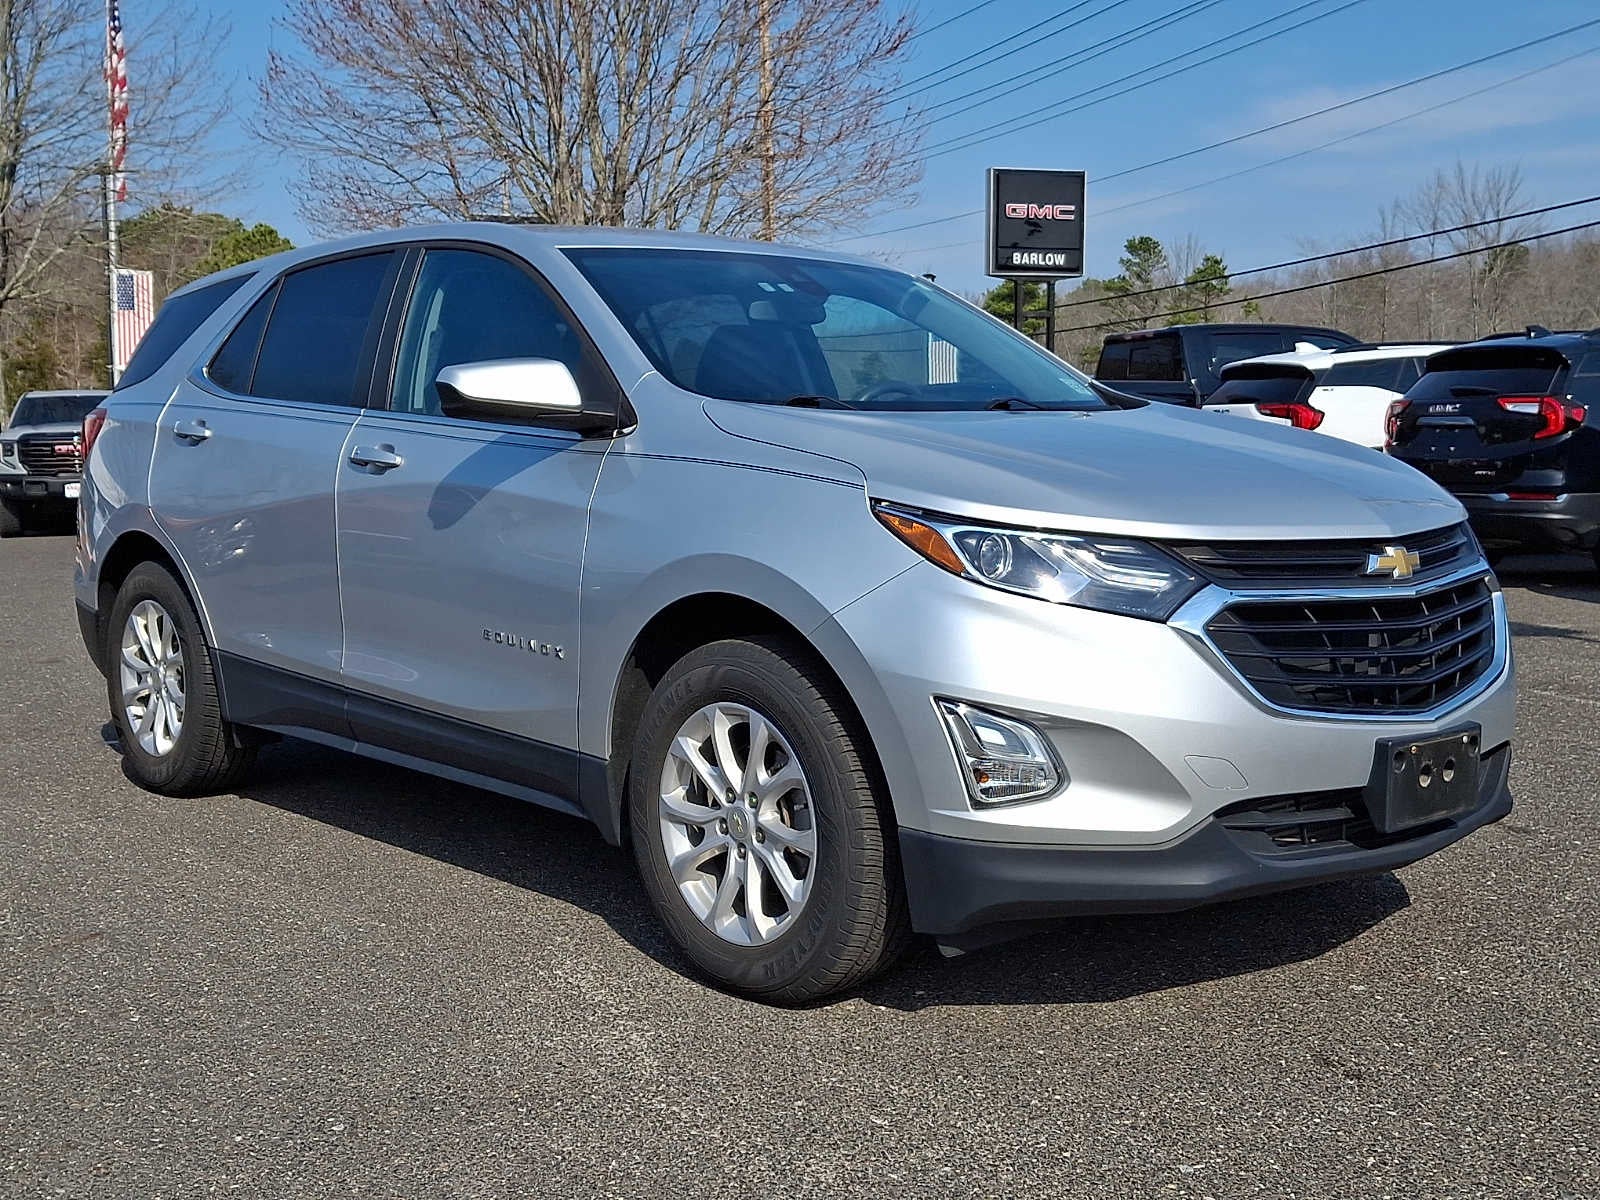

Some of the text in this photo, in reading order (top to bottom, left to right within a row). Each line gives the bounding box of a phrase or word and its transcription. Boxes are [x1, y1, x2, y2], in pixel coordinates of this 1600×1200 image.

[1005, 203, 1076, 220] GMC
[1012, 252, 1065, 266] BARLOW
[482, 628, 565, 661] EQUINOX
